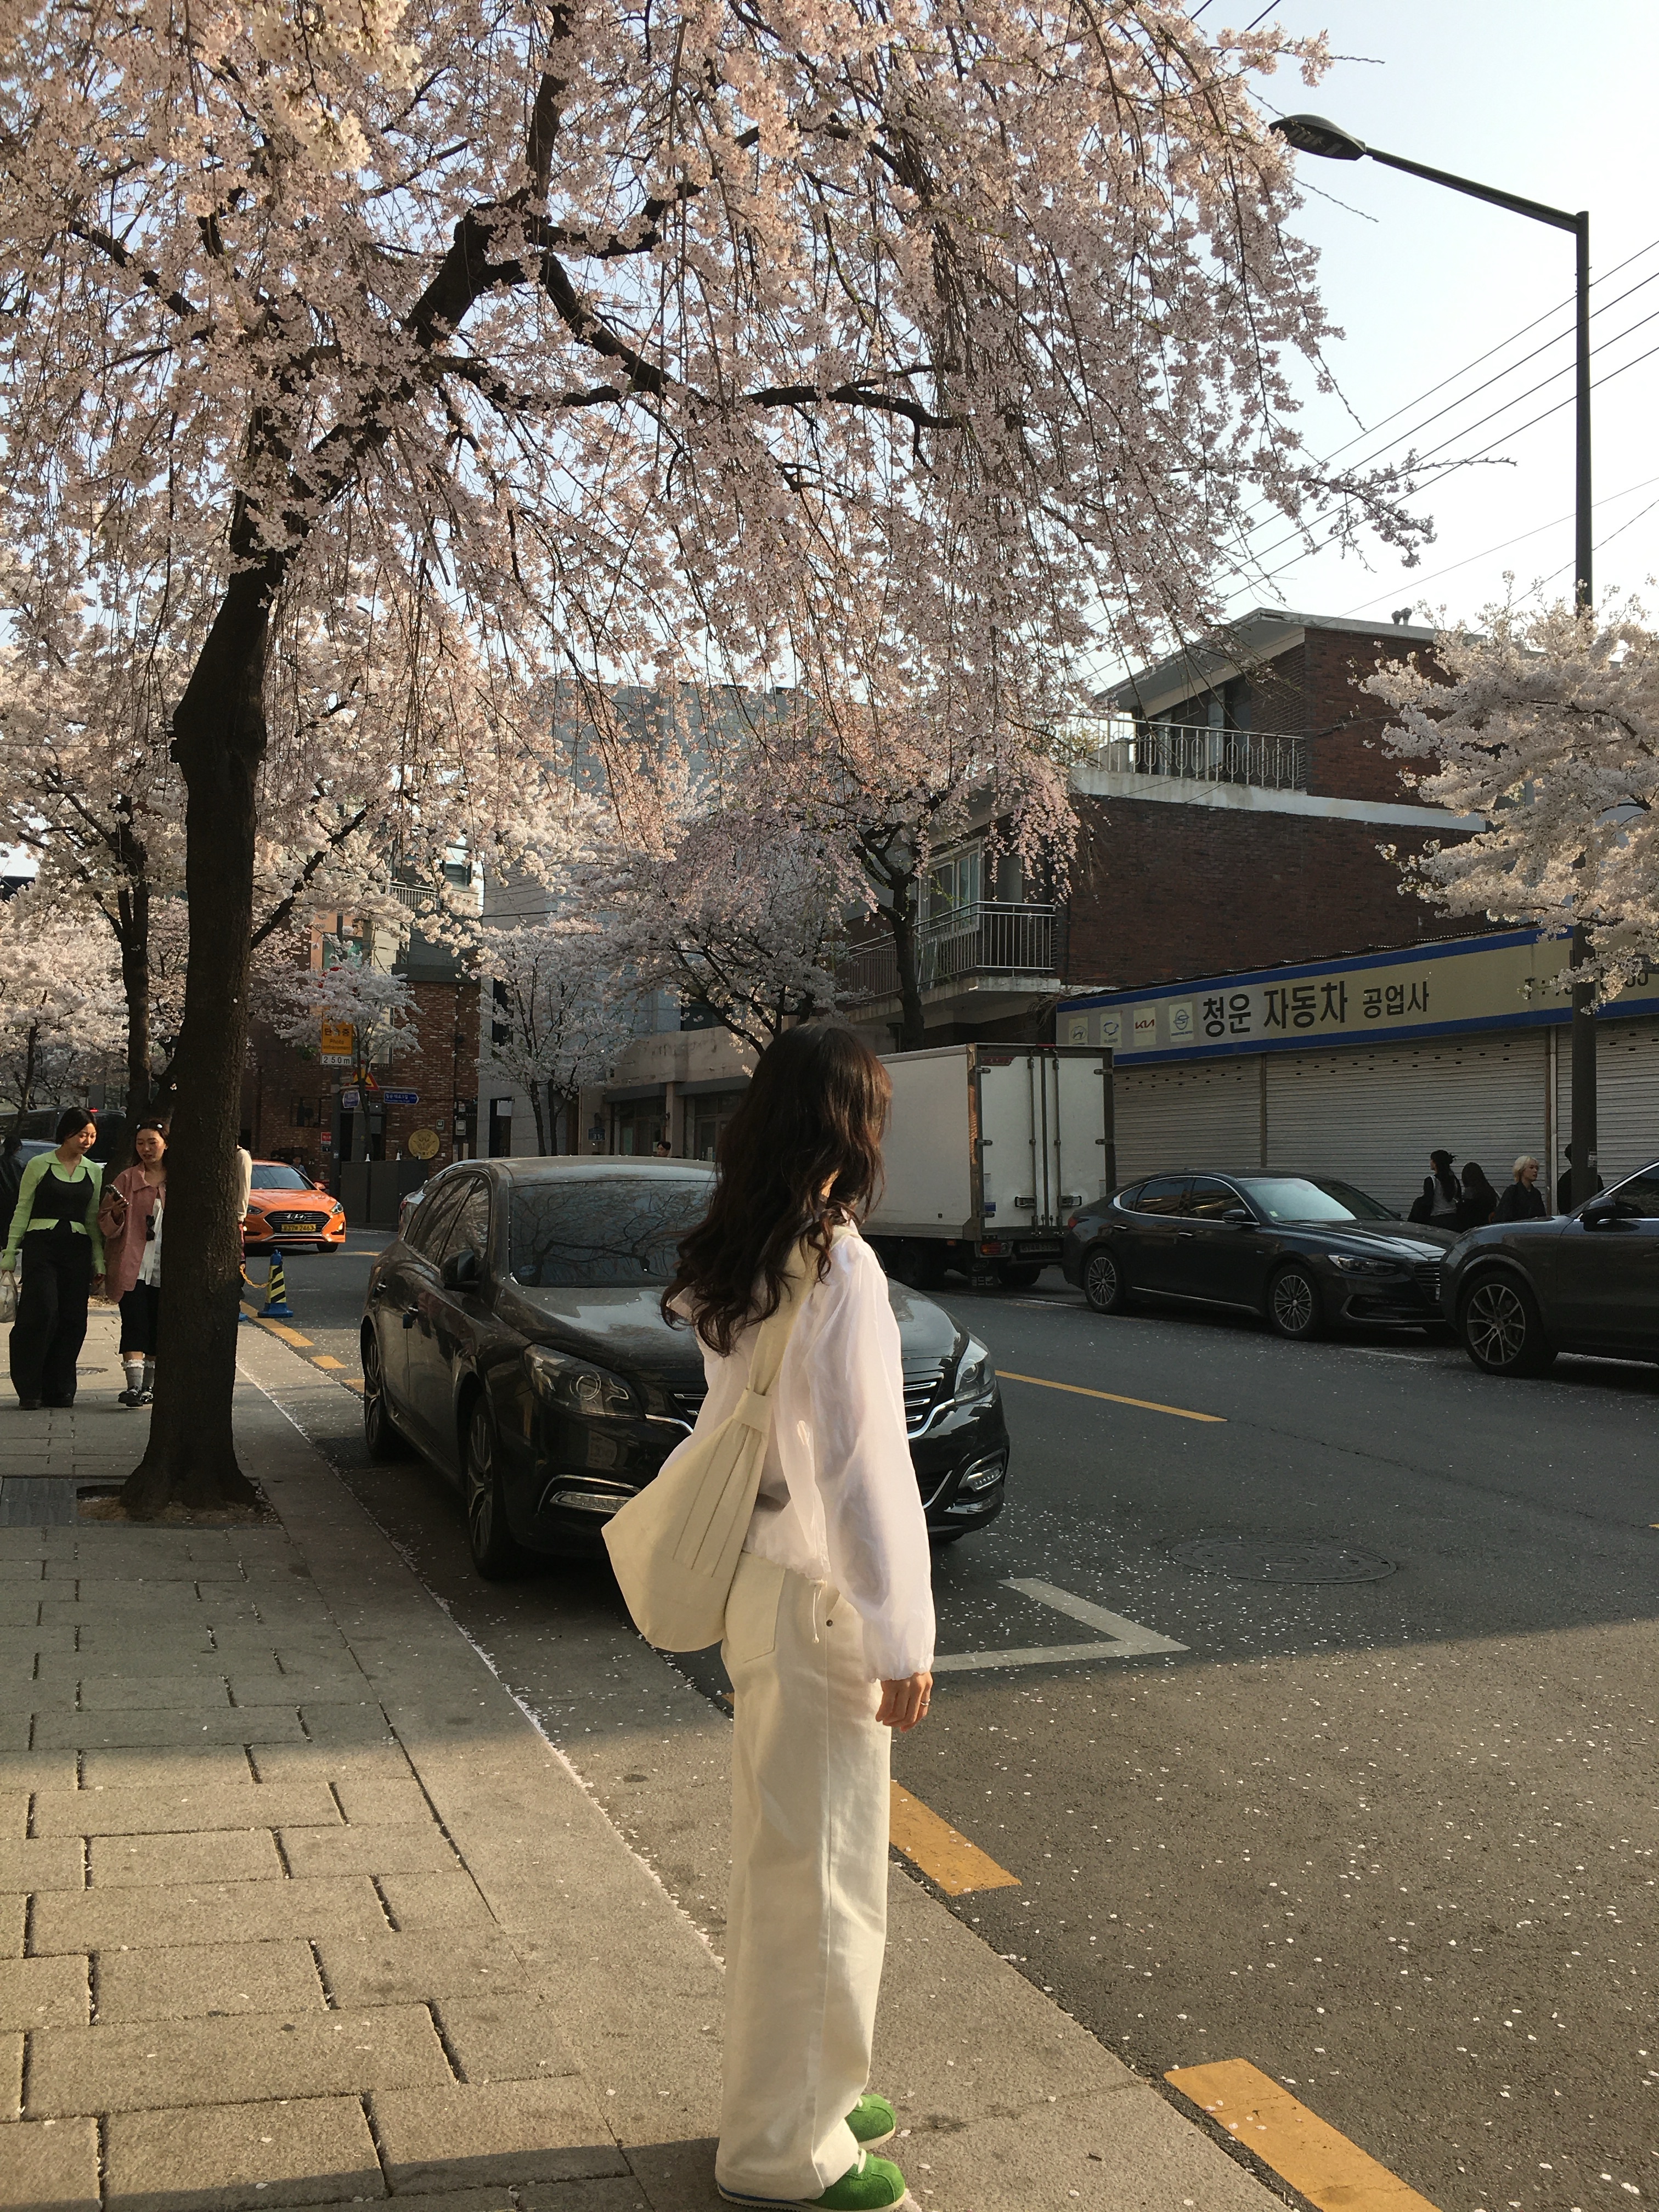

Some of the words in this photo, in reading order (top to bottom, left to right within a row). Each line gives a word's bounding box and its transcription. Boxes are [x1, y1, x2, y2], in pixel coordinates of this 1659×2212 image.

[1203, 994, 1251, 1037] 청운
[1263, 981, 1348, 1029] 자동차
[1363, 981, 1430, 1019] 공업사
[324, 1056, 350, 1064] 250m
